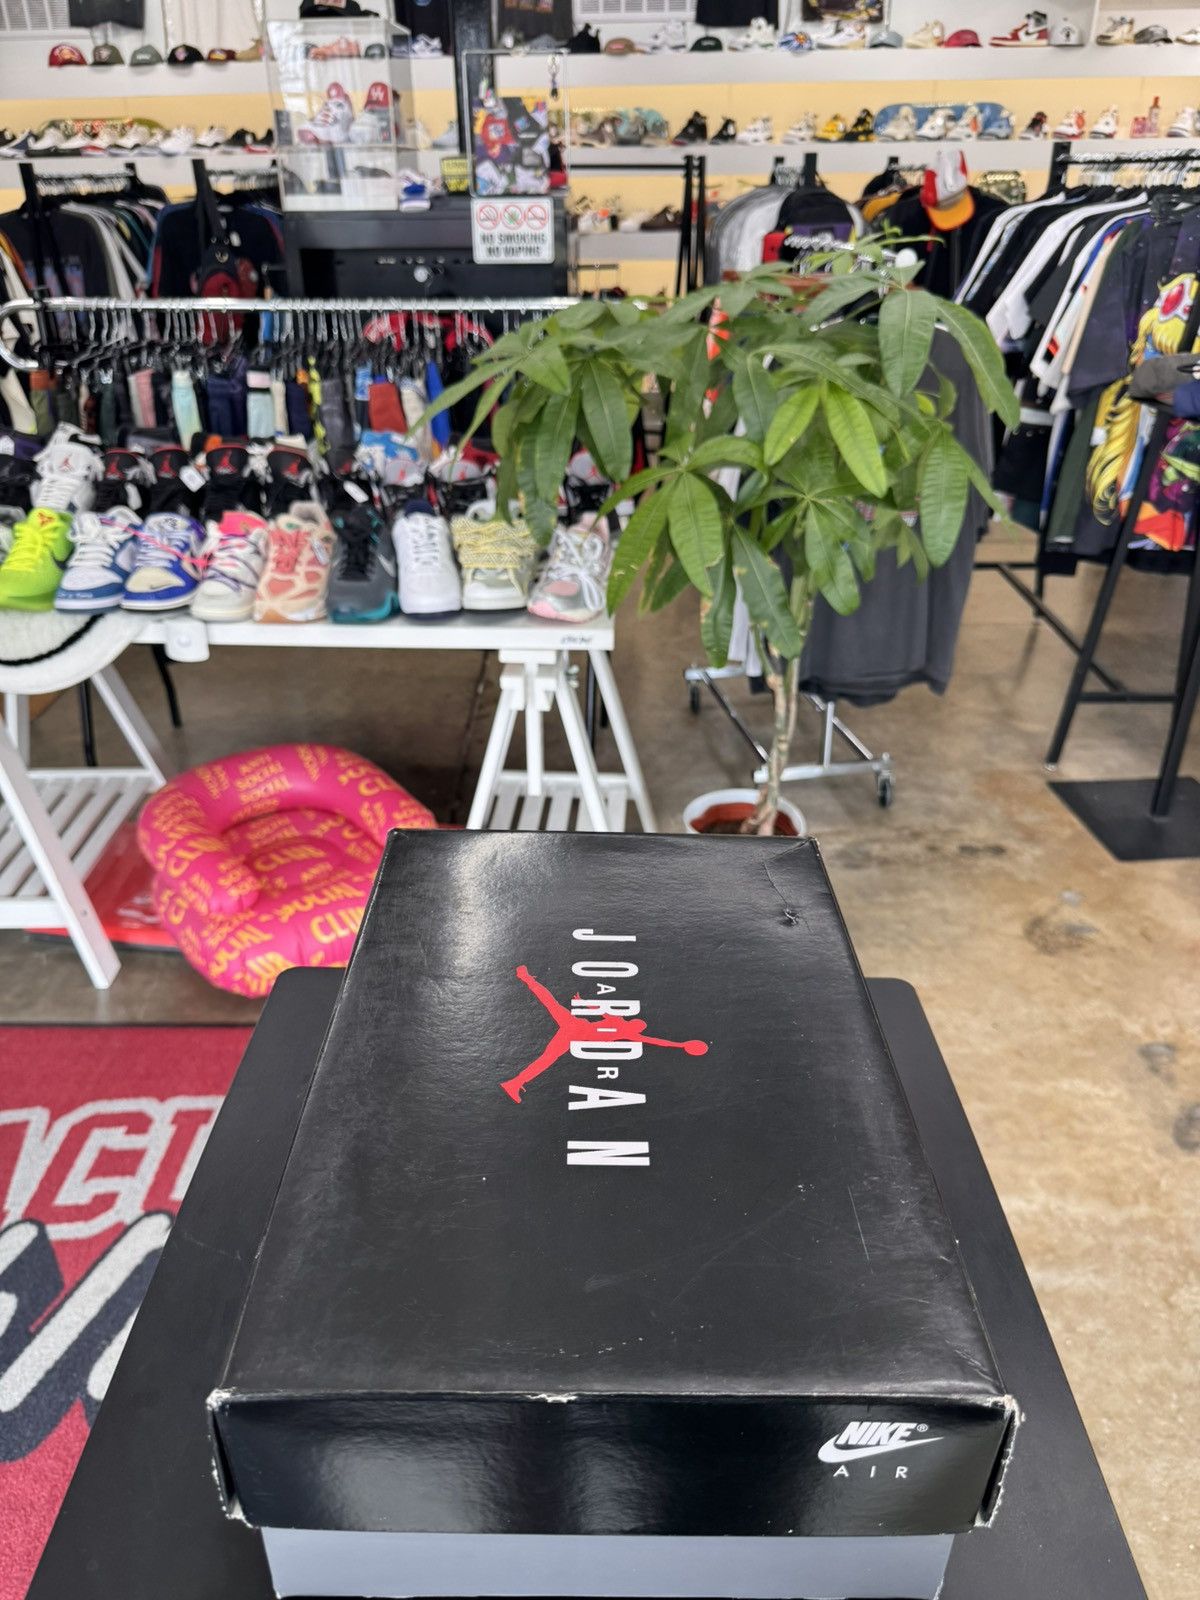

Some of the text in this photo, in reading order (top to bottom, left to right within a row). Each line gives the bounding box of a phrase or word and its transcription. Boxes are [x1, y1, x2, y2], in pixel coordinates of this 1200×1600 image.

[566, 928, 650, 1166] JORDAN
[596, 982, 619, 1079] AIR
[832, 1464, 908, 1479] AIR
